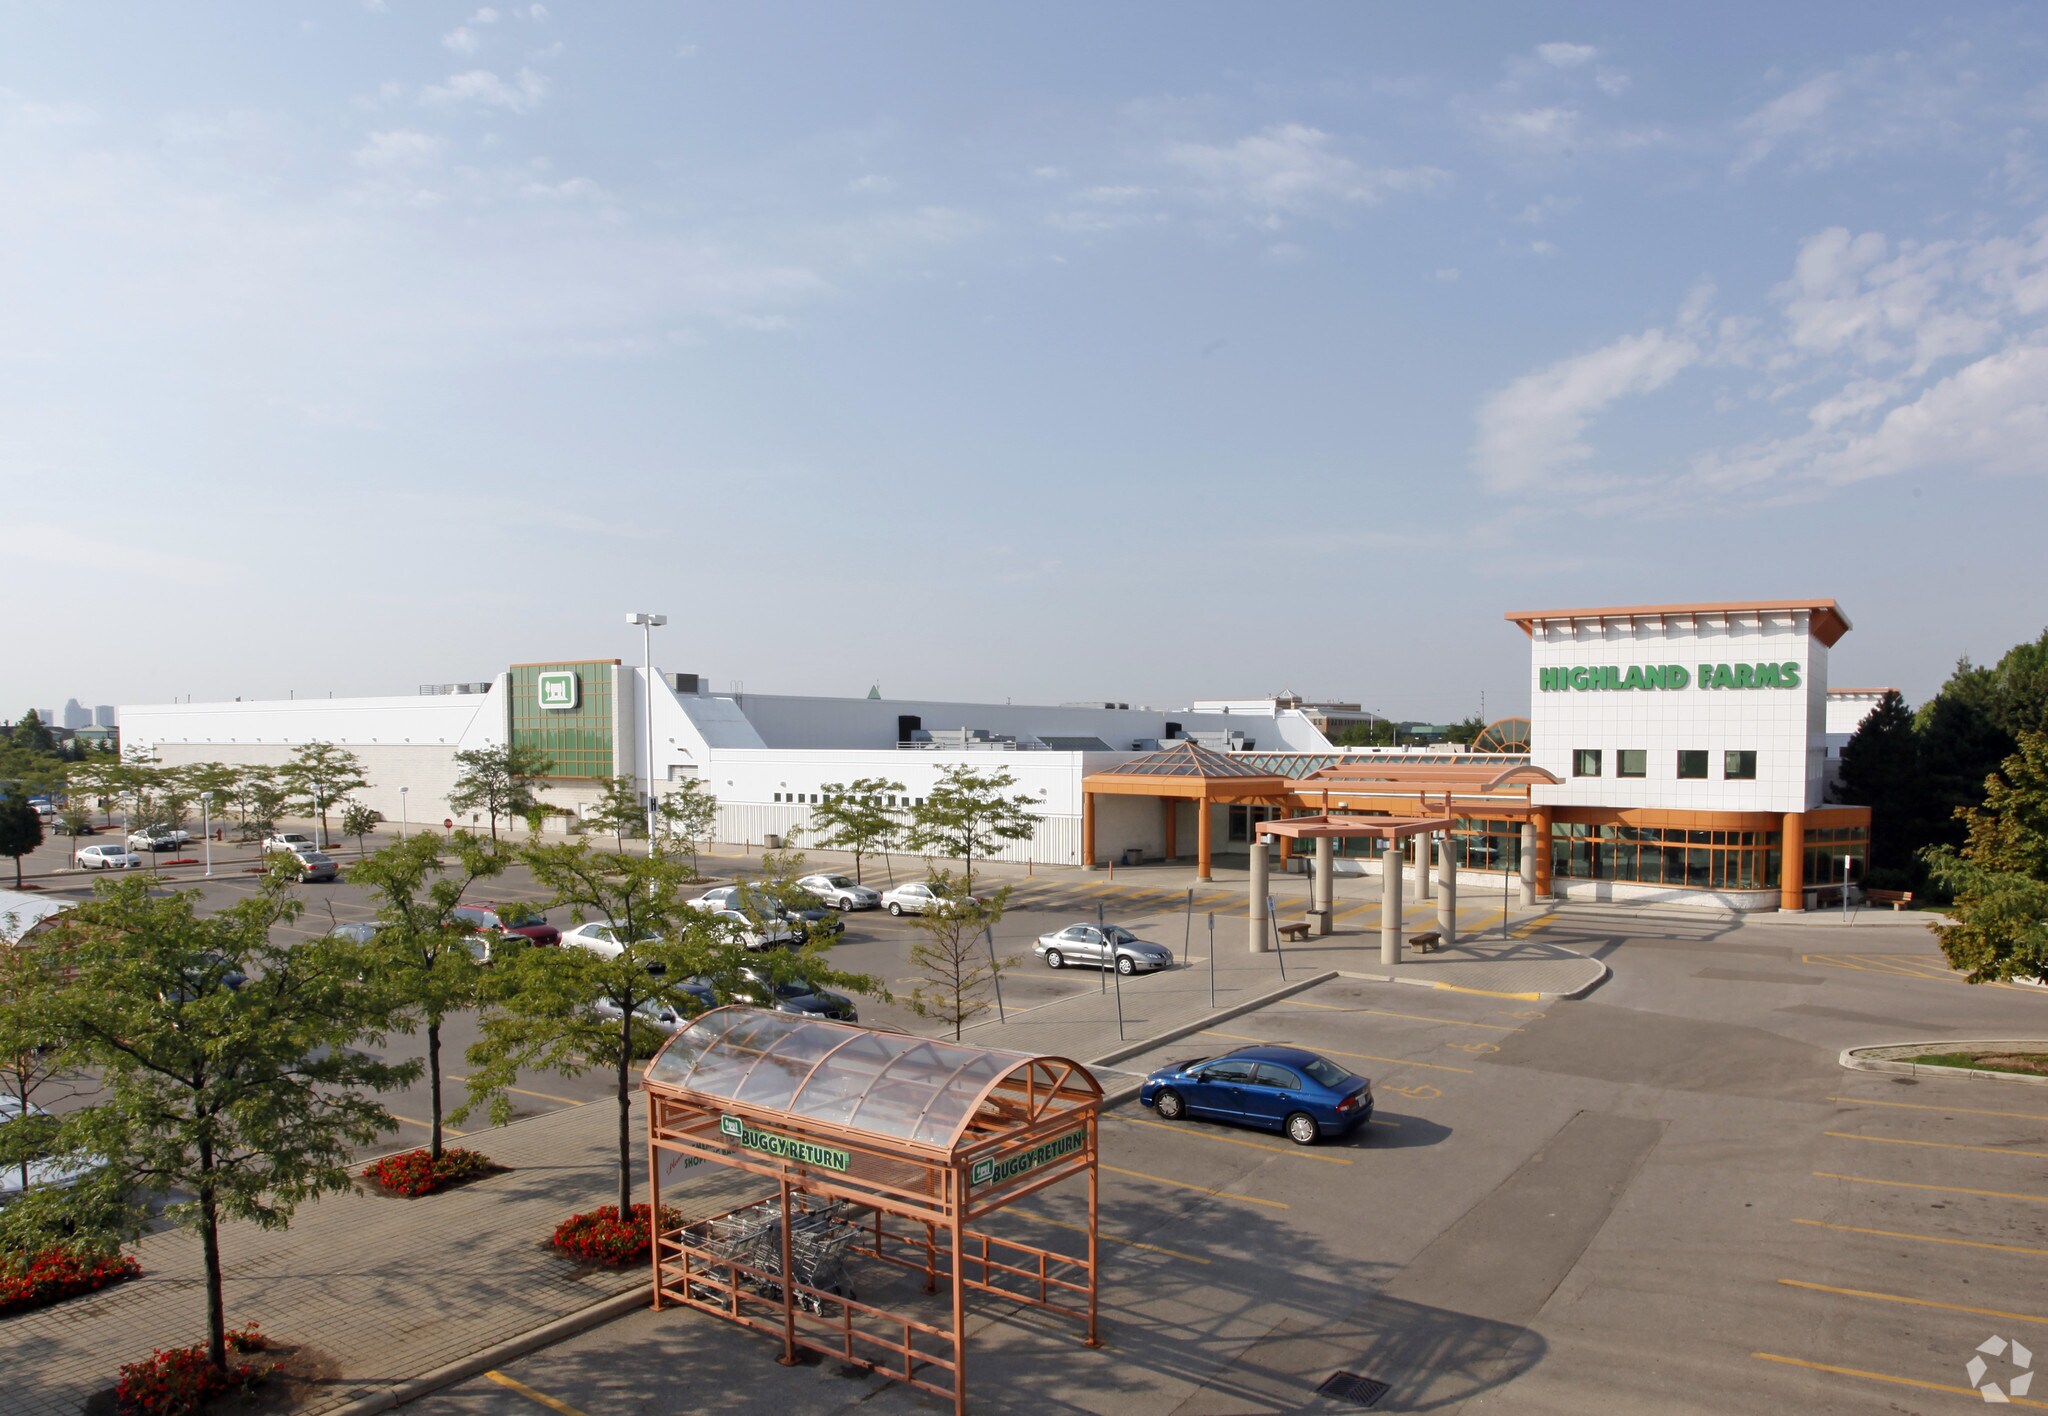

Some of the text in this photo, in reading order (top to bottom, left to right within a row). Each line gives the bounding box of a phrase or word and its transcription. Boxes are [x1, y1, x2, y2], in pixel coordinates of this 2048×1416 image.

[1539, 662, 1801, 691] HIGHLAND FARMS
[650, 798, 657, 811] H
[742, 1130, 788, 1154] BUGGY
[789, 1142, 845, 1169] RETURN
[993, 1132, 1081, 1182] BUGGY RETURN
